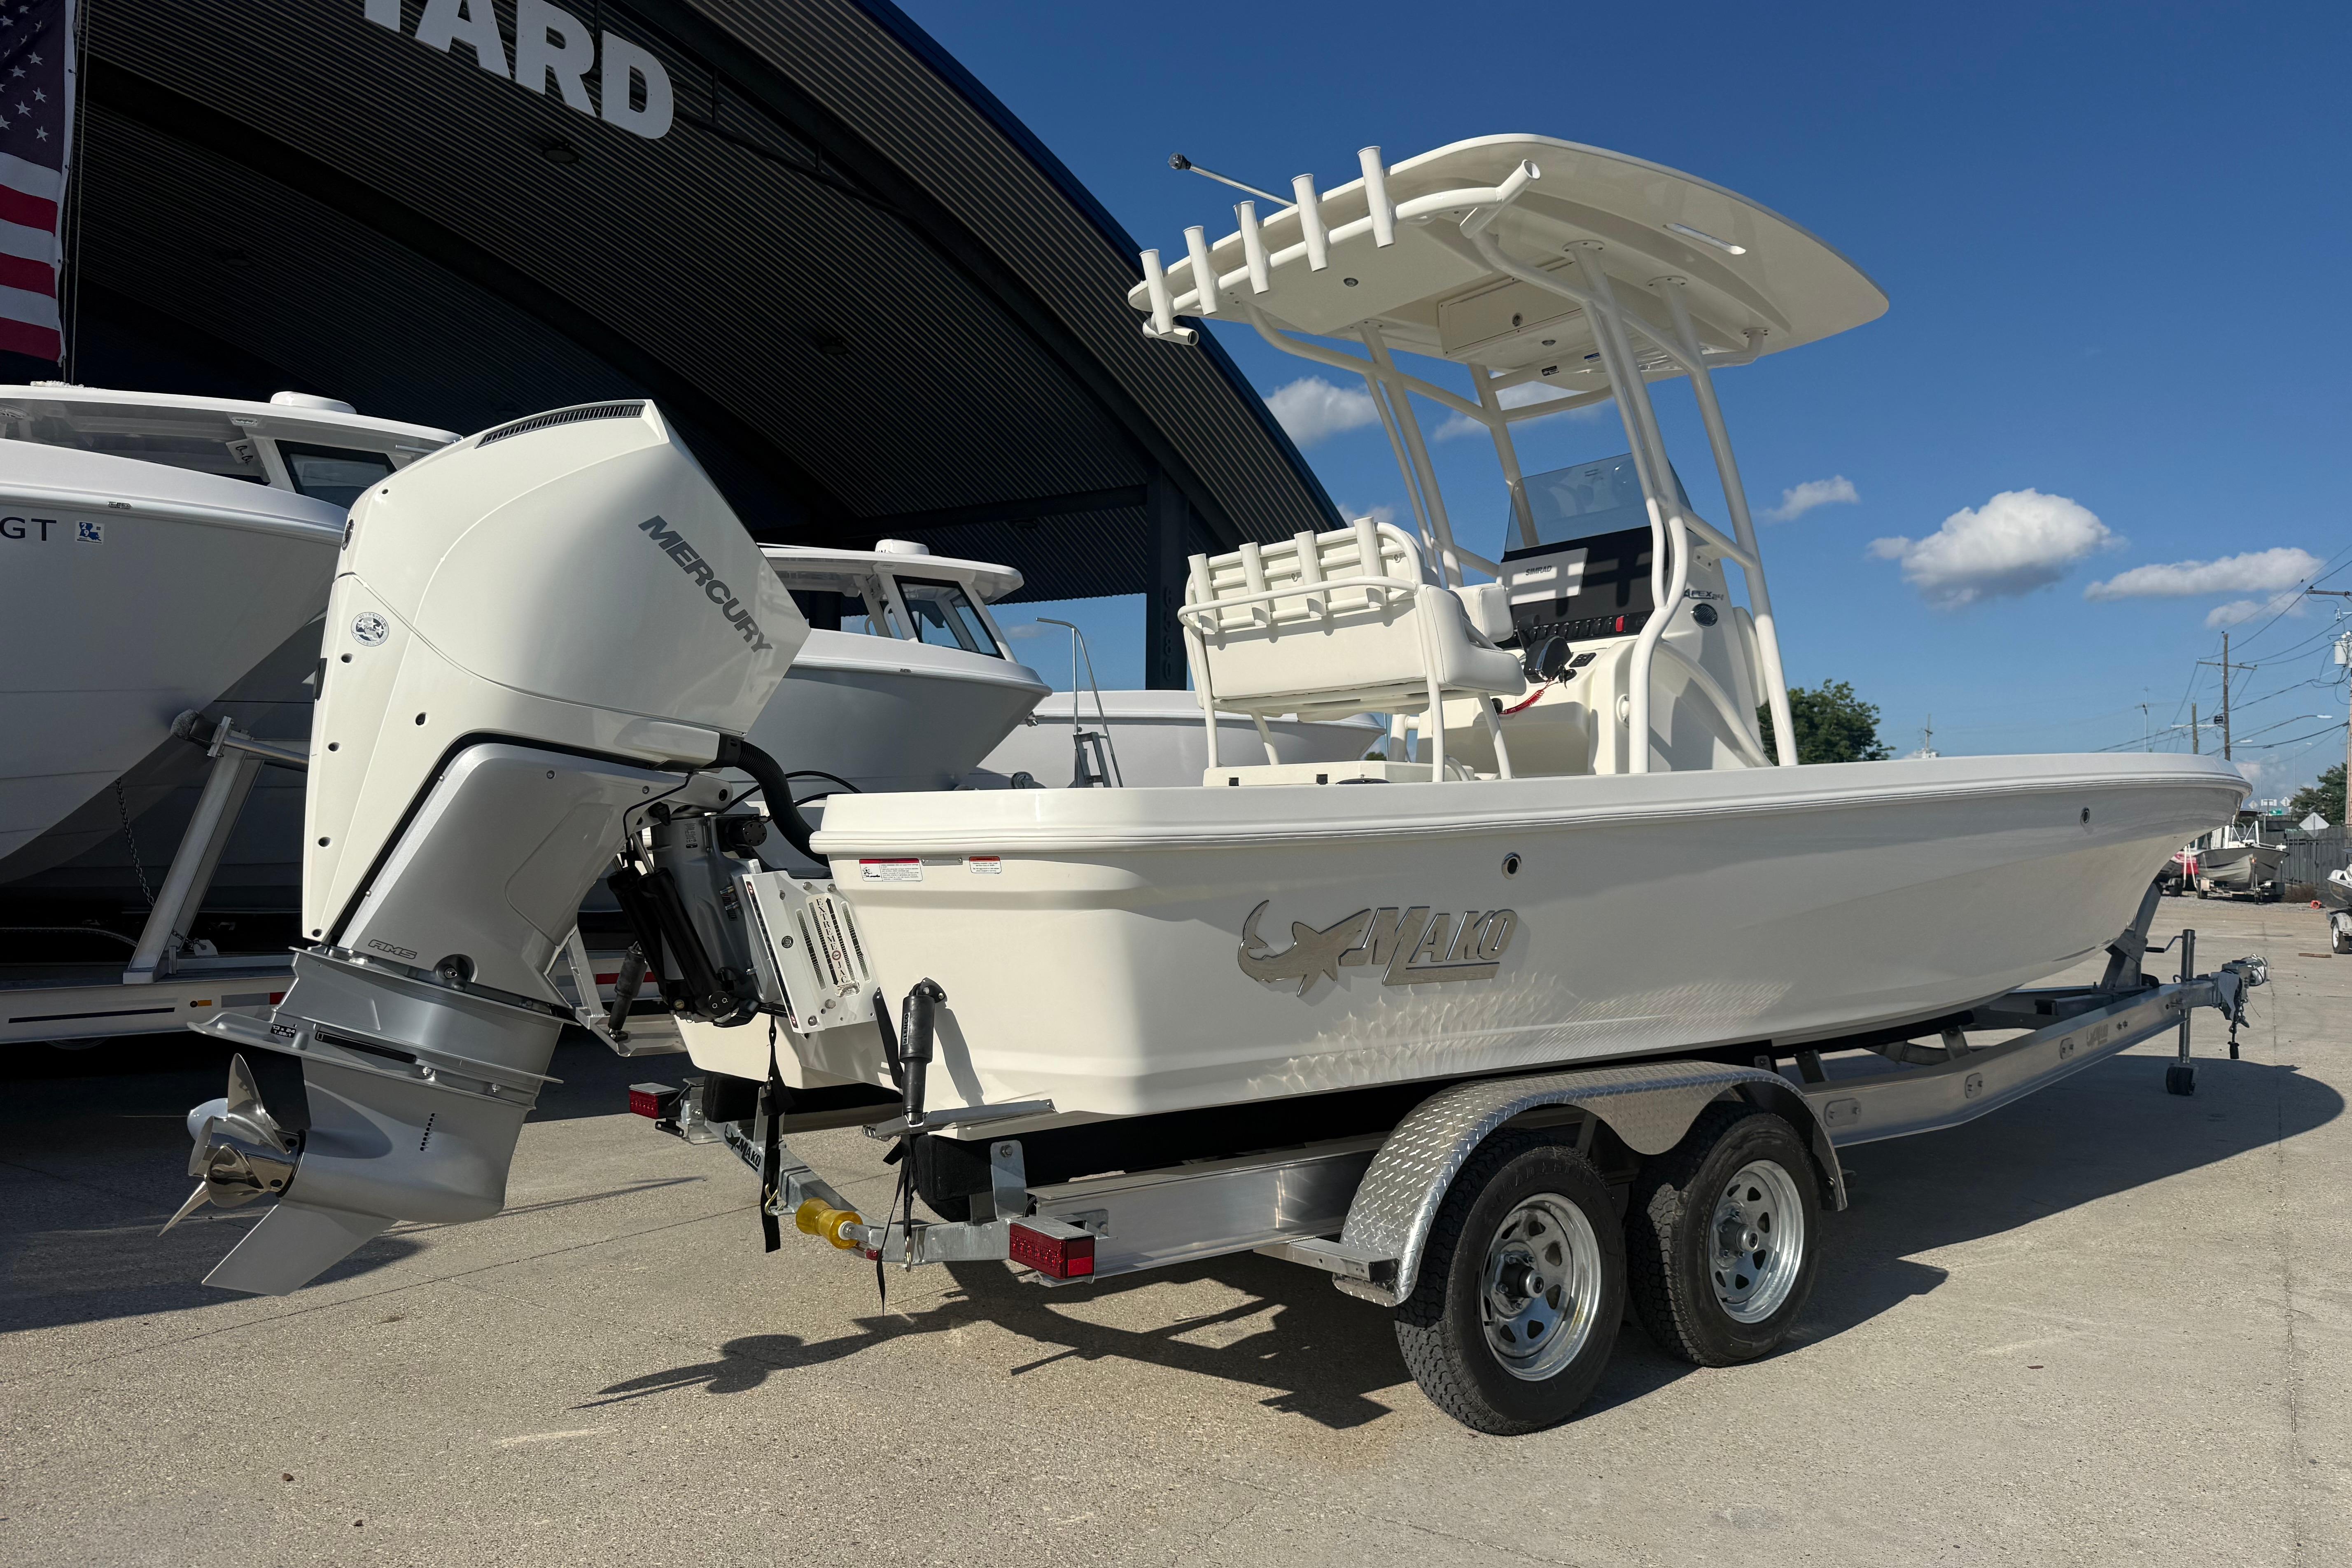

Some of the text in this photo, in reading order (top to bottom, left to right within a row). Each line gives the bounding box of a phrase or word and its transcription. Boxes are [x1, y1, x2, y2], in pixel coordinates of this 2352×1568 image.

[0, 517, 56, 541] GT
[638, 515, 773, 653] MERCURY
[1526, 565, 1552, 576] SIMRAD
[1683, 588, 1712, 599] APEX
[816, 898, 837, 950] EXTREME
[368, 939, 418, 959] AMS
[1339, 905, 1518, 986] MAKO
[736, 1138, 761, 1172] MAKO
